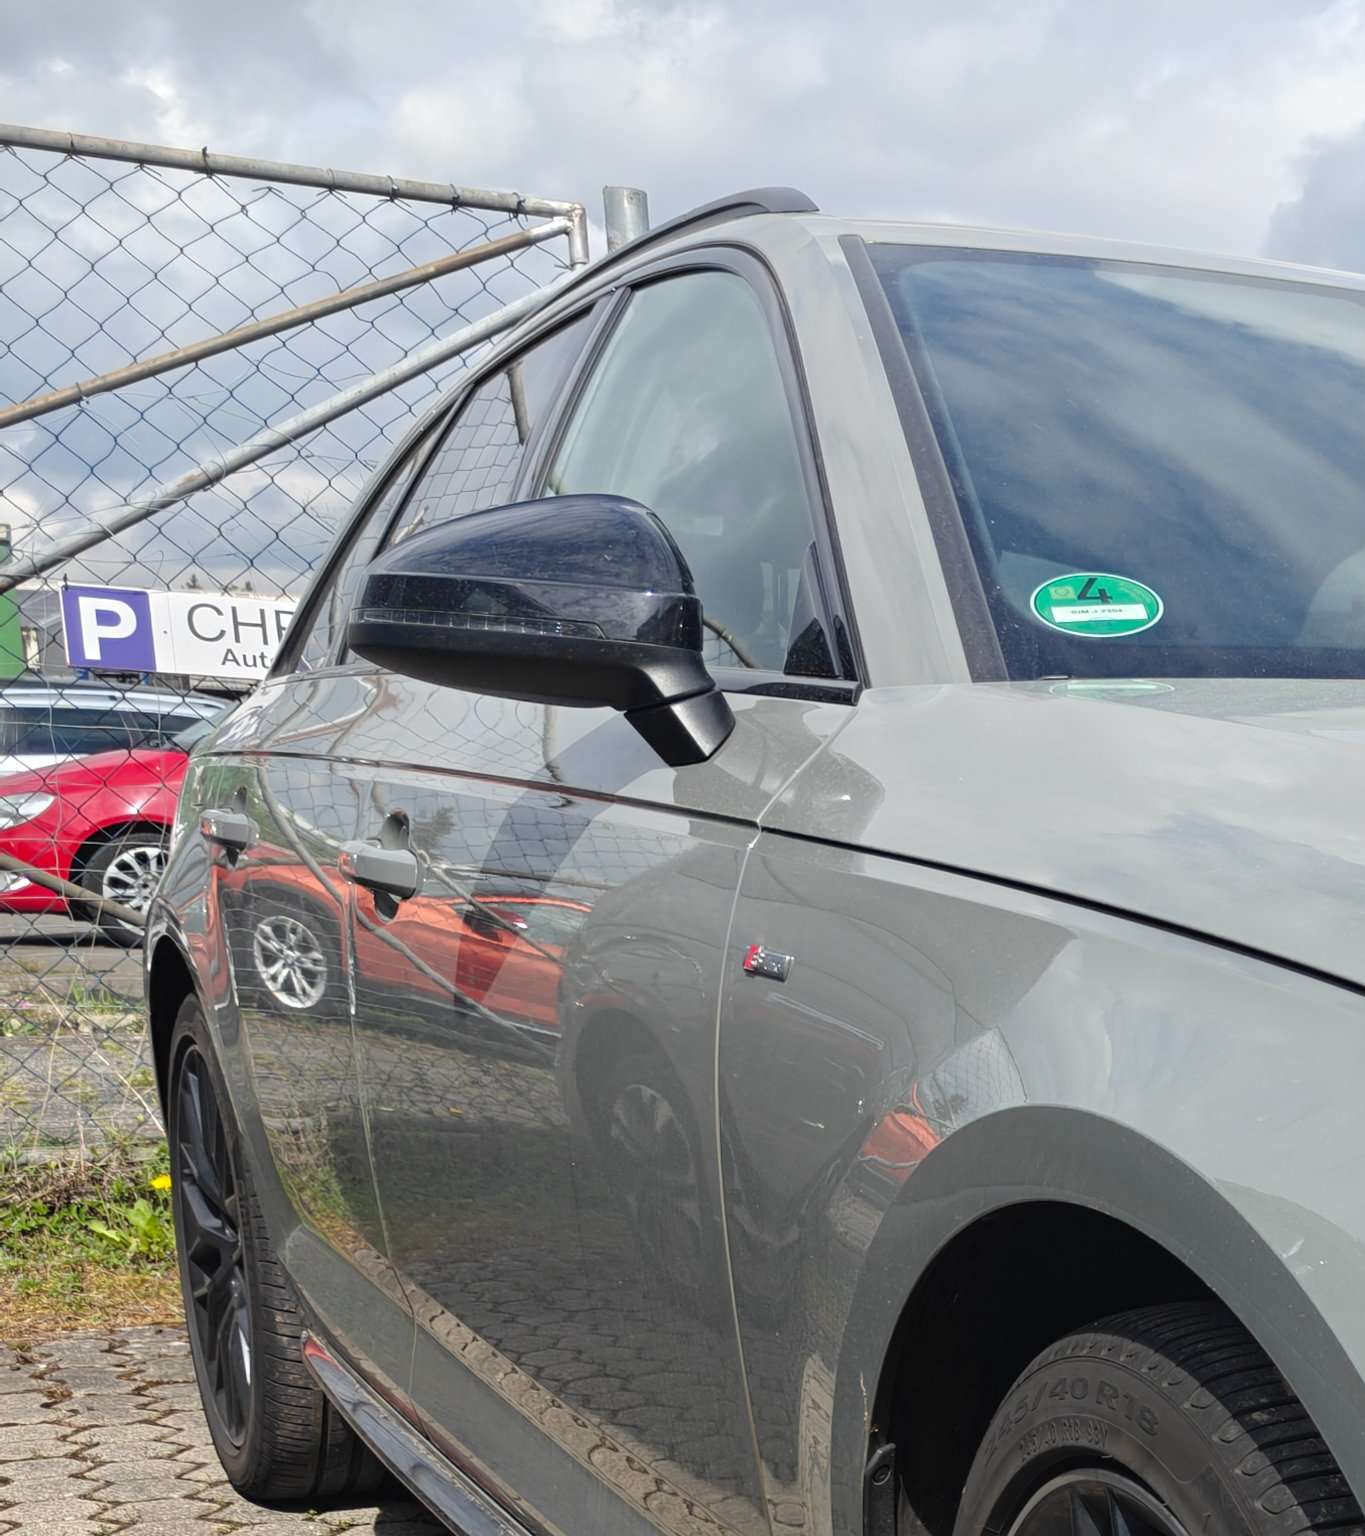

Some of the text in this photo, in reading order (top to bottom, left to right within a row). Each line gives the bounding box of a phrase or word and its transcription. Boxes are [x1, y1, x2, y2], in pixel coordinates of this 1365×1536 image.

[1077, 577, 1113, 604] 4
[77, 596, 138, 661] P
[221, 648, 273, 669] Aut
